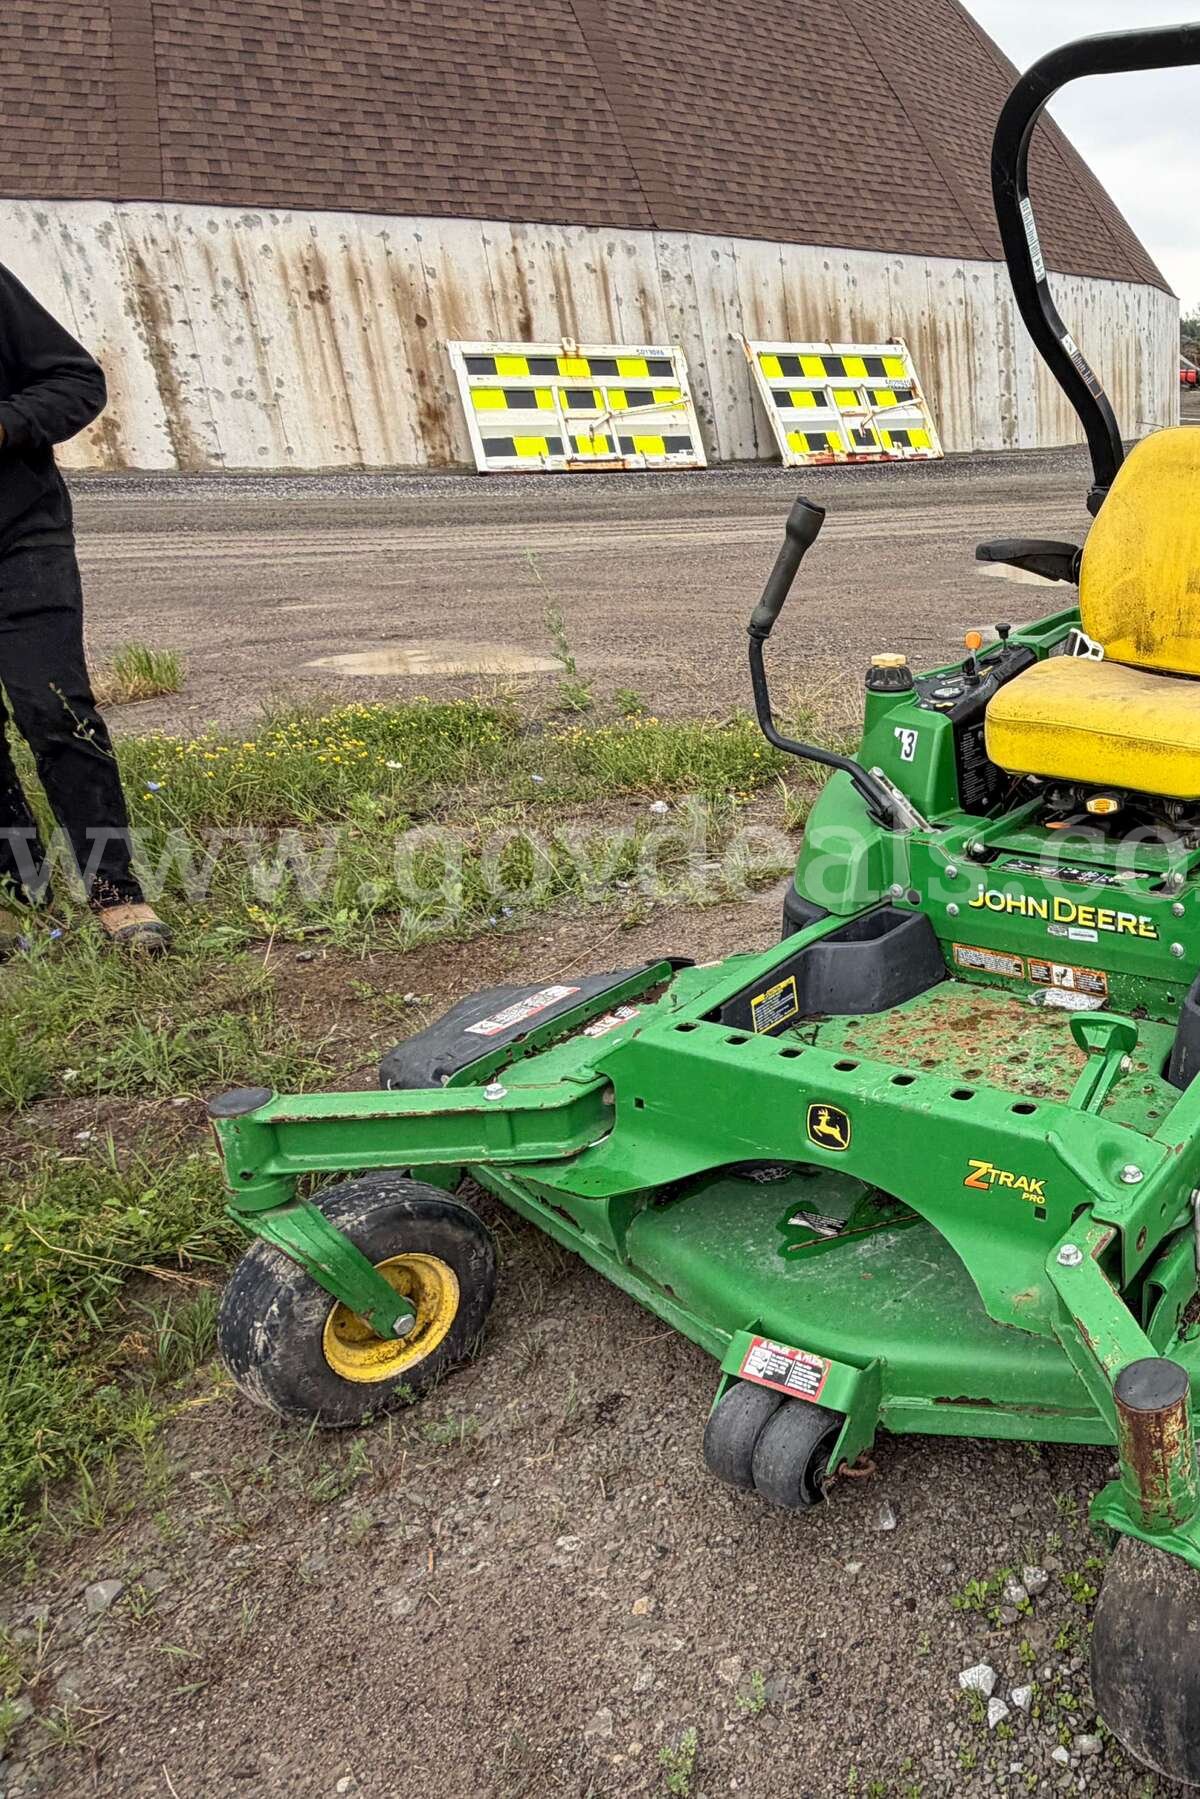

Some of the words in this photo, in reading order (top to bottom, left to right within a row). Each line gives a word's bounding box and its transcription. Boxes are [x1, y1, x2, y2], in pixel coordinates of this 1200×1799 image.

[968, 884, 1048, 920] JOHN
[1053, 897, 1158, 939] DEERE
[1022, 1191, 1046, 1204] PRO
